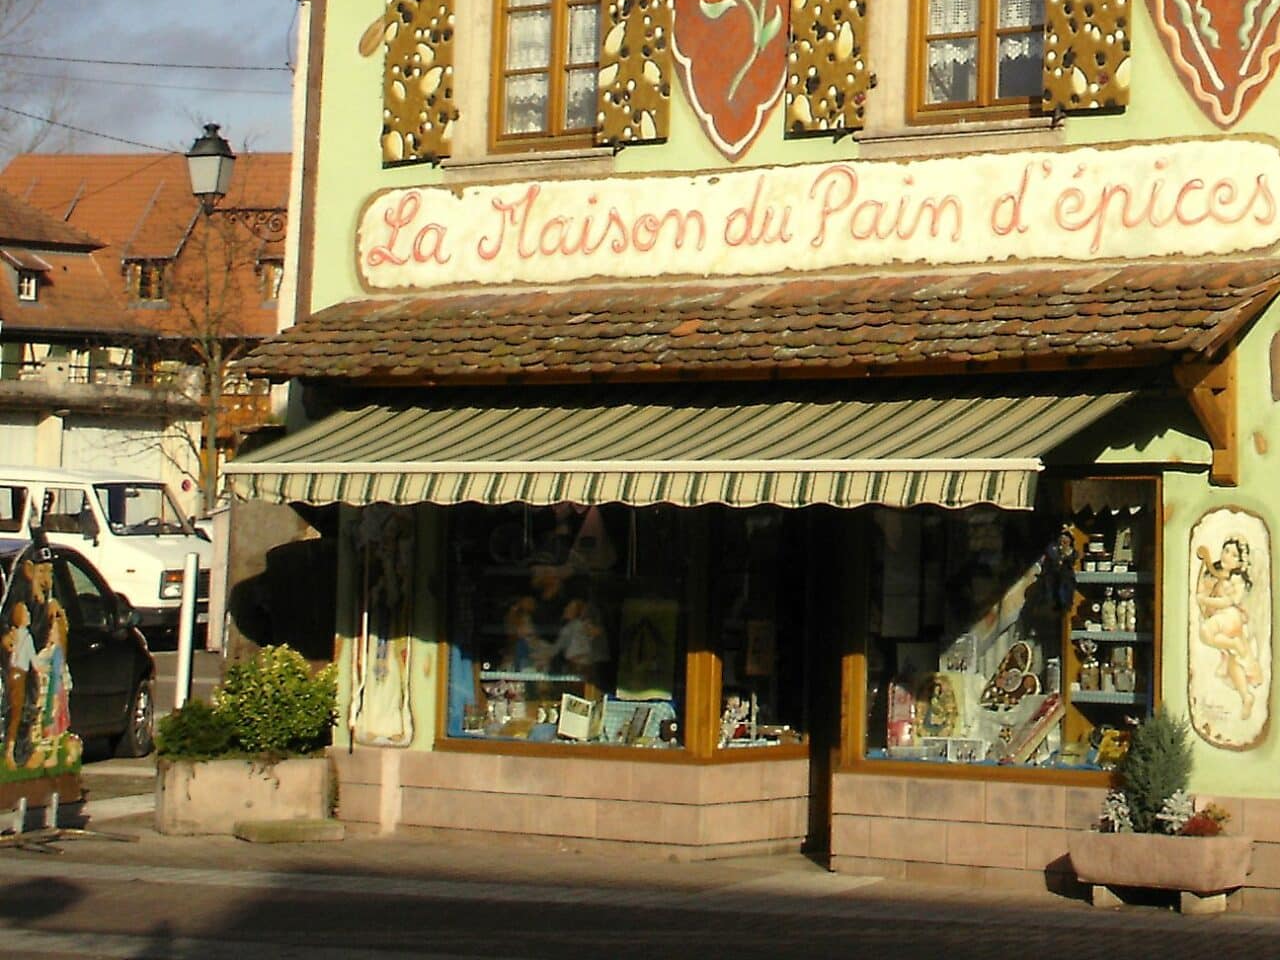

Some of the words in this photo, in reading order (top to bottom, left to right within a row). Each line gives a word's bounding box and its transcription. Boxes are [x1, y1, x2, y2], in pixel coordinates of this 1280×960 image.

[367, 191, 451, 266] La
[477, 183, 706, 261] Maison
[723, 174, 793, 247] du
[809, 163, 962, 248] Pain
[990, 157, 1277, 255] d'épices
